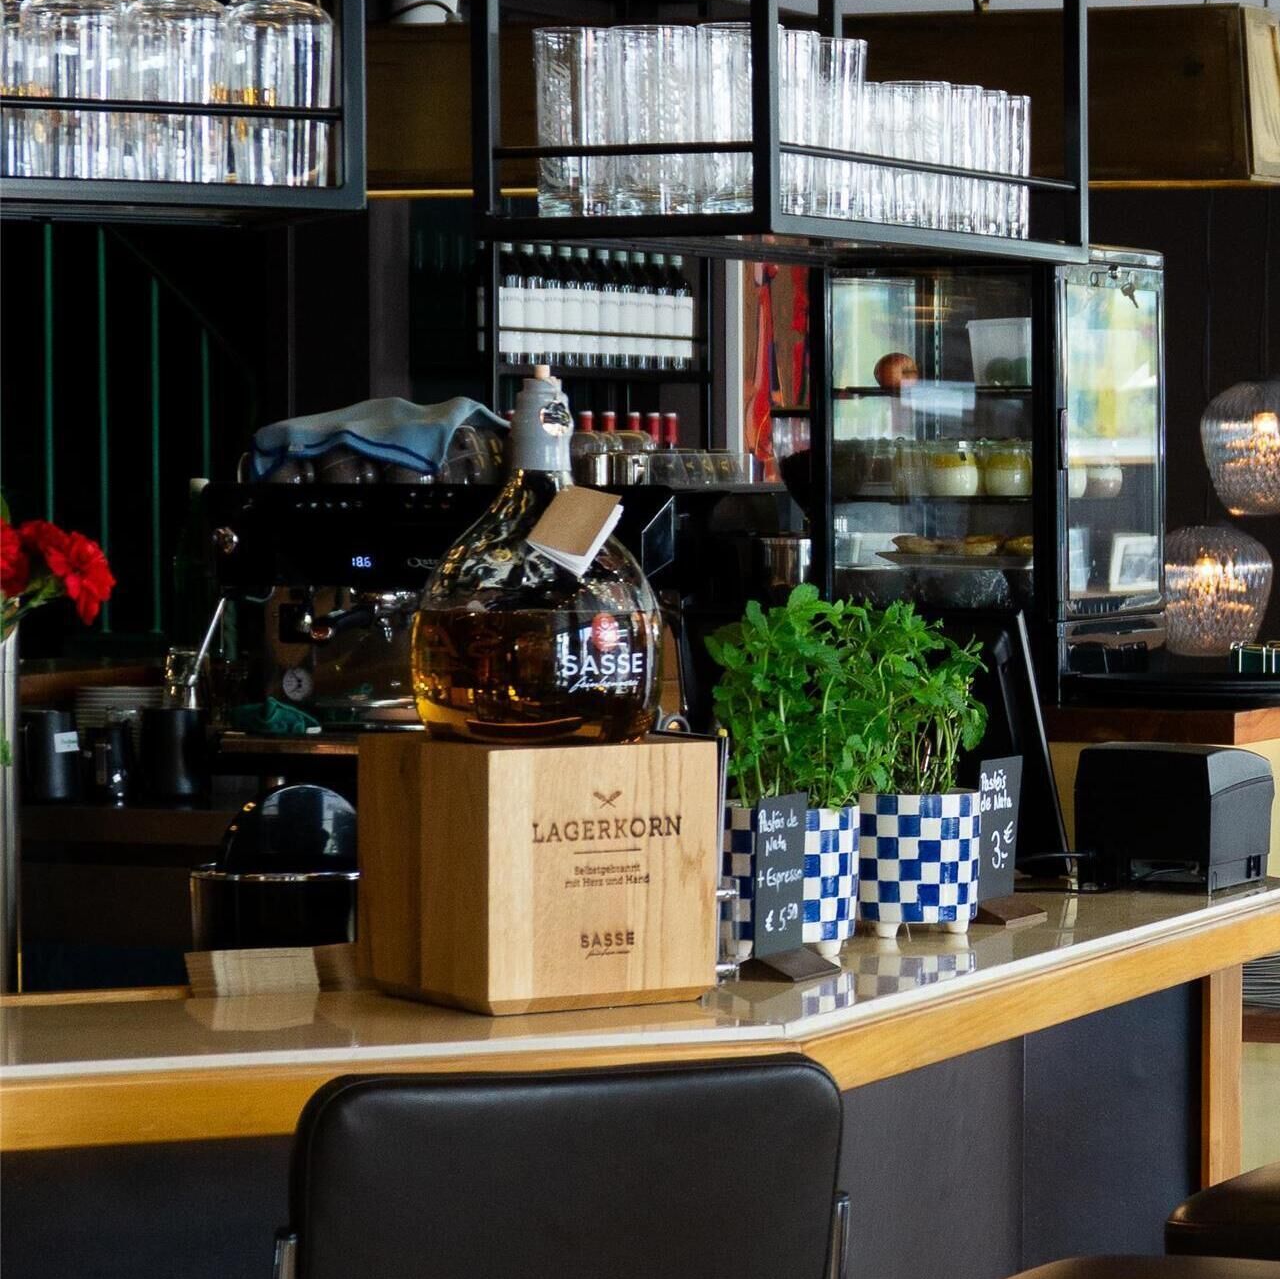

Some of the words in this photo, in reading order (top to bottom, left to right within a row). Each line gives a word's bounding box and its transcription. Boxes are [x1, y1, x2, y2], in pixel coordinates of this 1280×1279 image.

[561, 652, 643, 675] SASSE
[981, 794, 992, 813] de
[994, 789, 1012, 811] Nata
[532, 814, 682, 843] LAGERKORN
[787, 809, 799, 828] de
[767, 866, 803, 891] Espresso
[580, 931, 634, 948] SASSE
